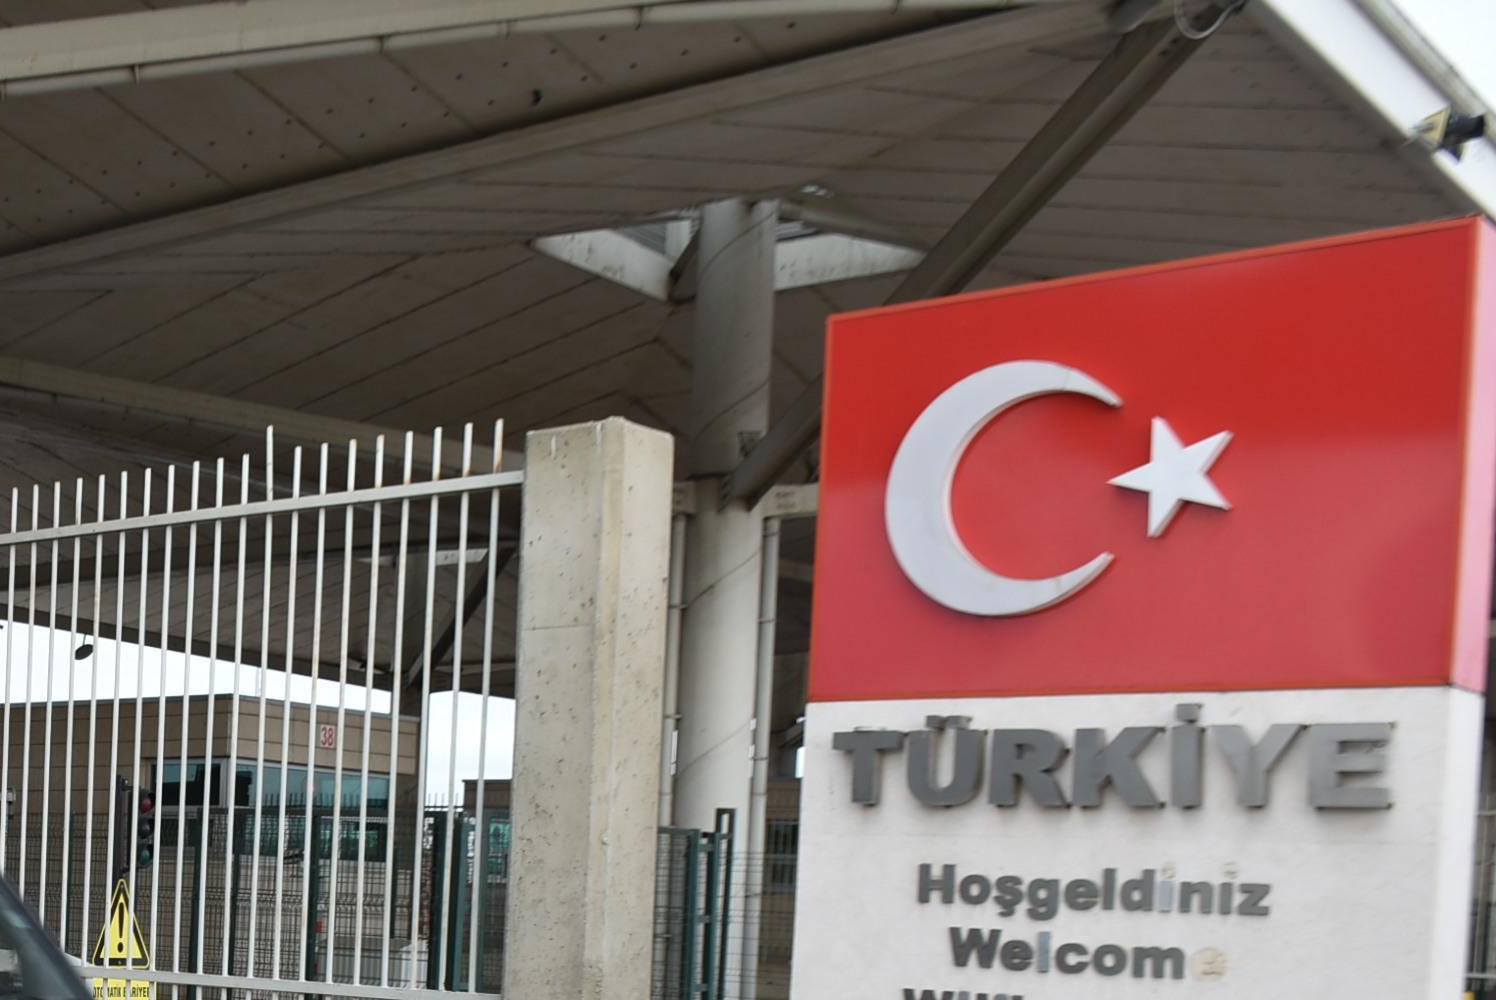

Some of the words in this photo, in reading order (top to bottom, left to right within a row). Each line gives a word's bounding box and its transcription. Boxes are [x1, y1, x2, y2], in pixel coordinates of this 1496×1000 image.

[320, 726, 334, 746] 38
[832, 703, 1394, 809] TÜRKİYE
[917, 861, 1271, 921] Hoşgeldiniz
[93, 984, 122, 998] OTOATİK
